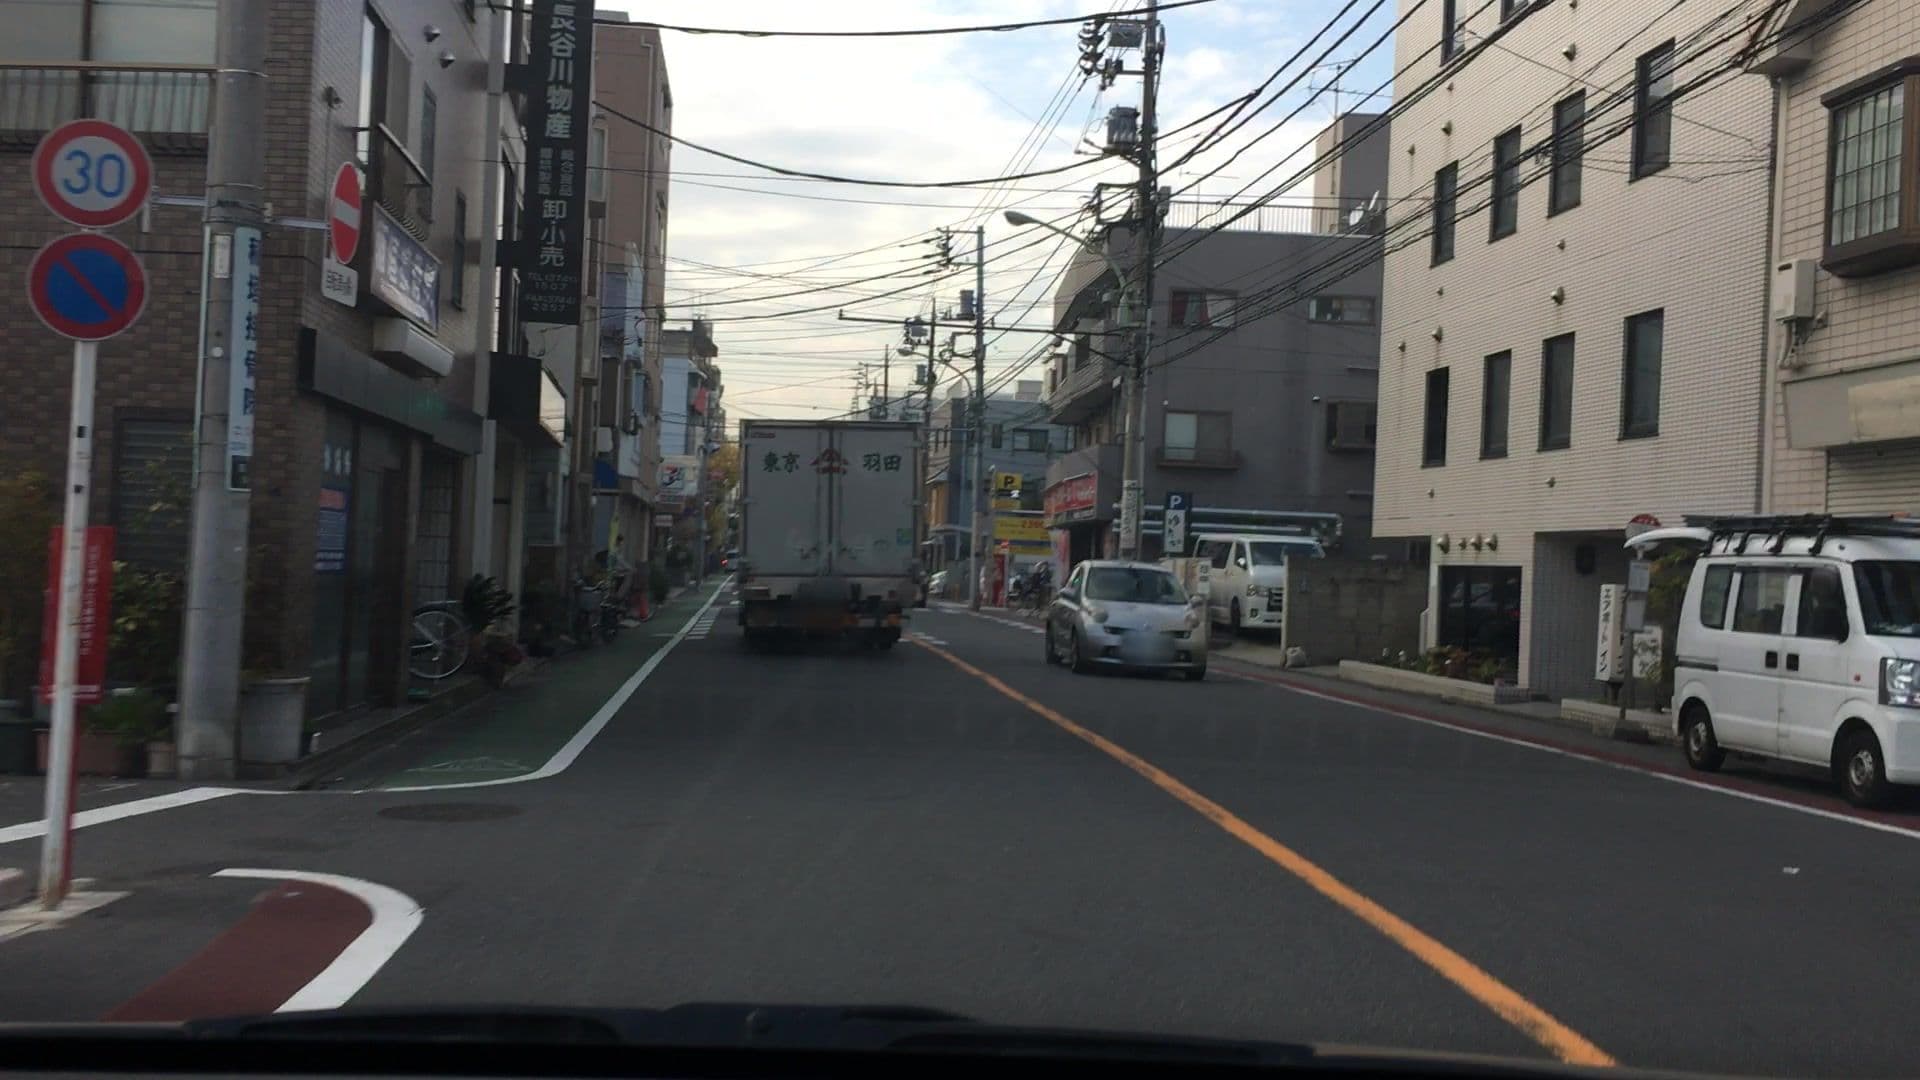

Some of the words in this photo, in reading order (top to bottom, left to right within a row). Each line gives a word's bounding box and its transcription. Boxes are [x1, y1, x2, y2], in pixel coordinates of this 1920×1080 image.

[545, 0, 576, 139] 長谷川物産
[61, 149, 127, 199] 30
[762, 451, 800, 473] 東京
[863, 453, 903, 473] 羽田
[1003, 475, 1015, 487] P
[1169, 495, 1183, 508] P
